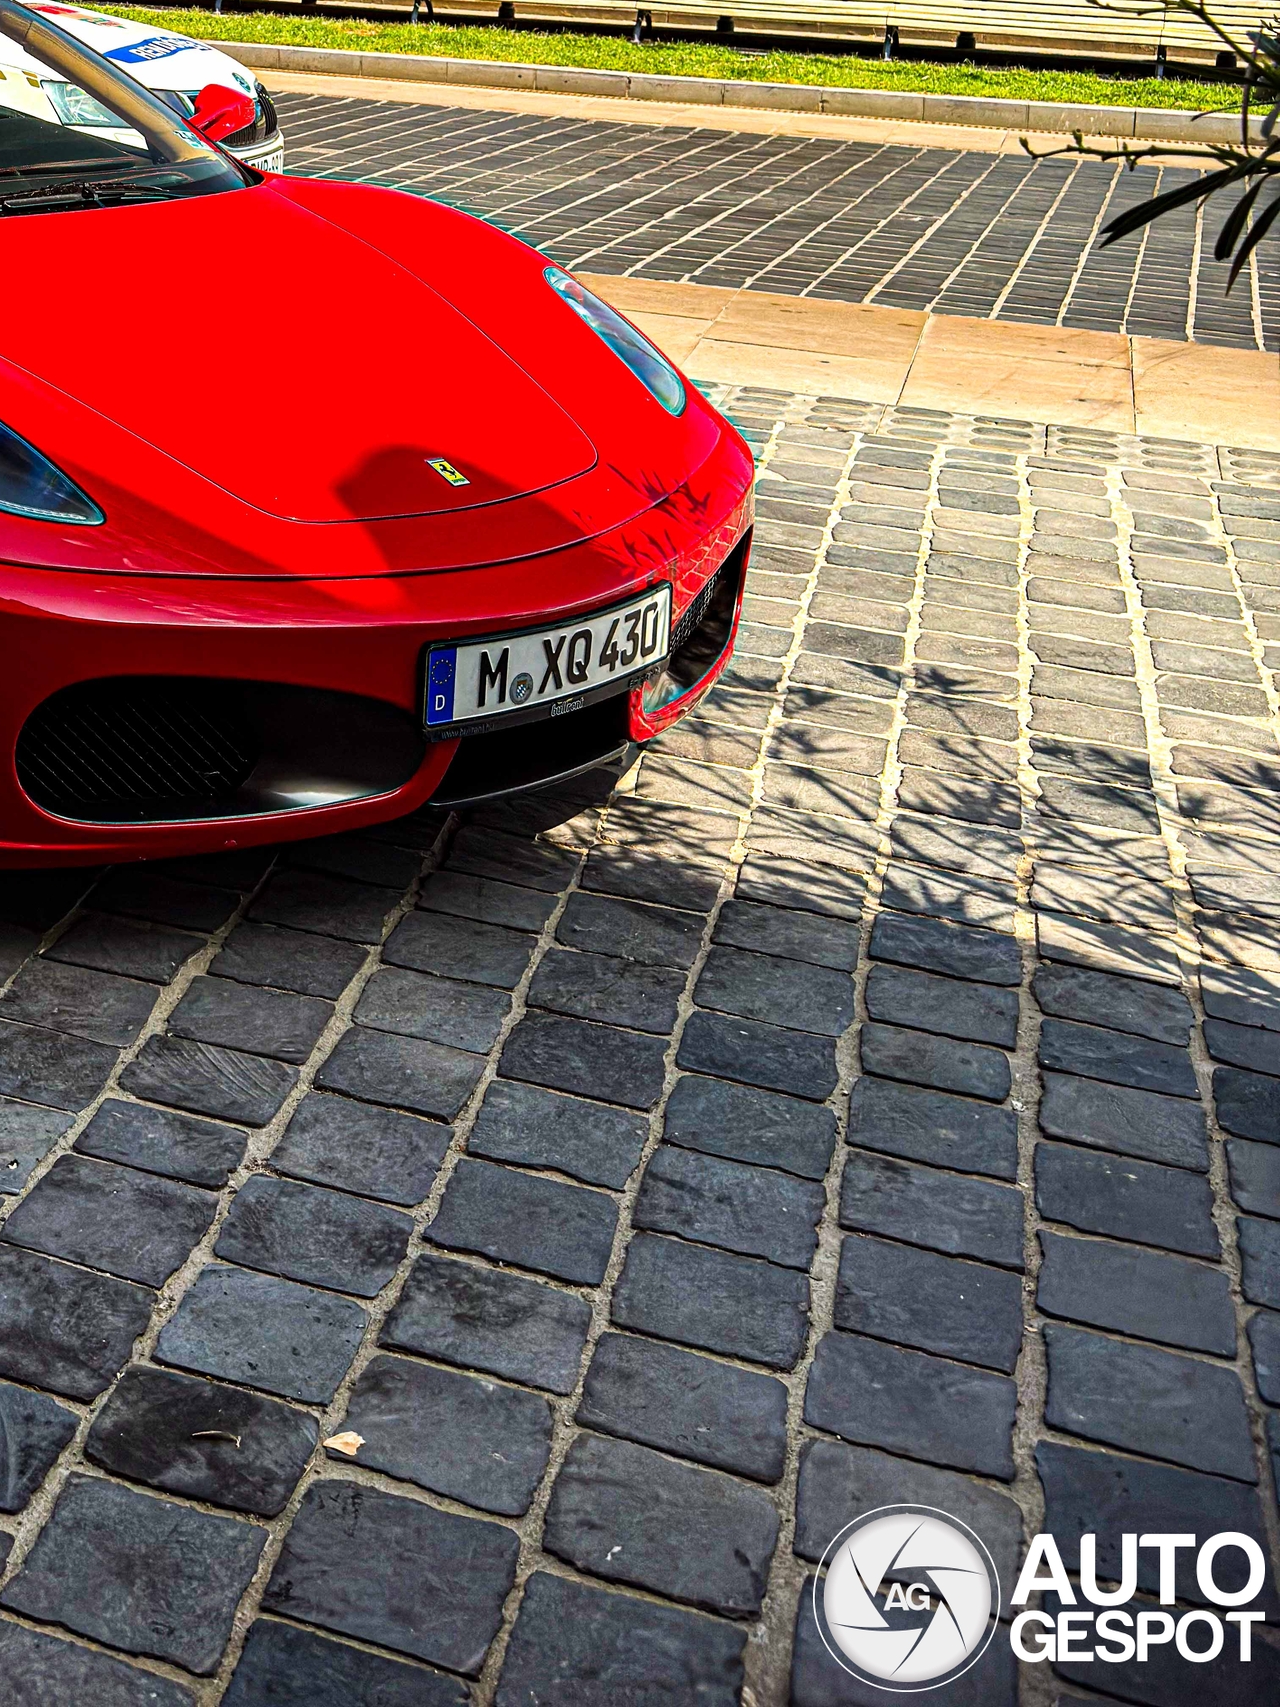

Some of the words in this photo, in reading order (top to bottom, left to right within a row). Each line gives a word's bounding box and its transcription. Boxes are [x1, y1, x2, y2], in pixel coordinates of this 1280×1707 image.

[478, 646, 510, 708] M
[538, 628, 593, 694] XQ
[599, 600, 659, 672] 430
[435, 695, 446, 711] D
